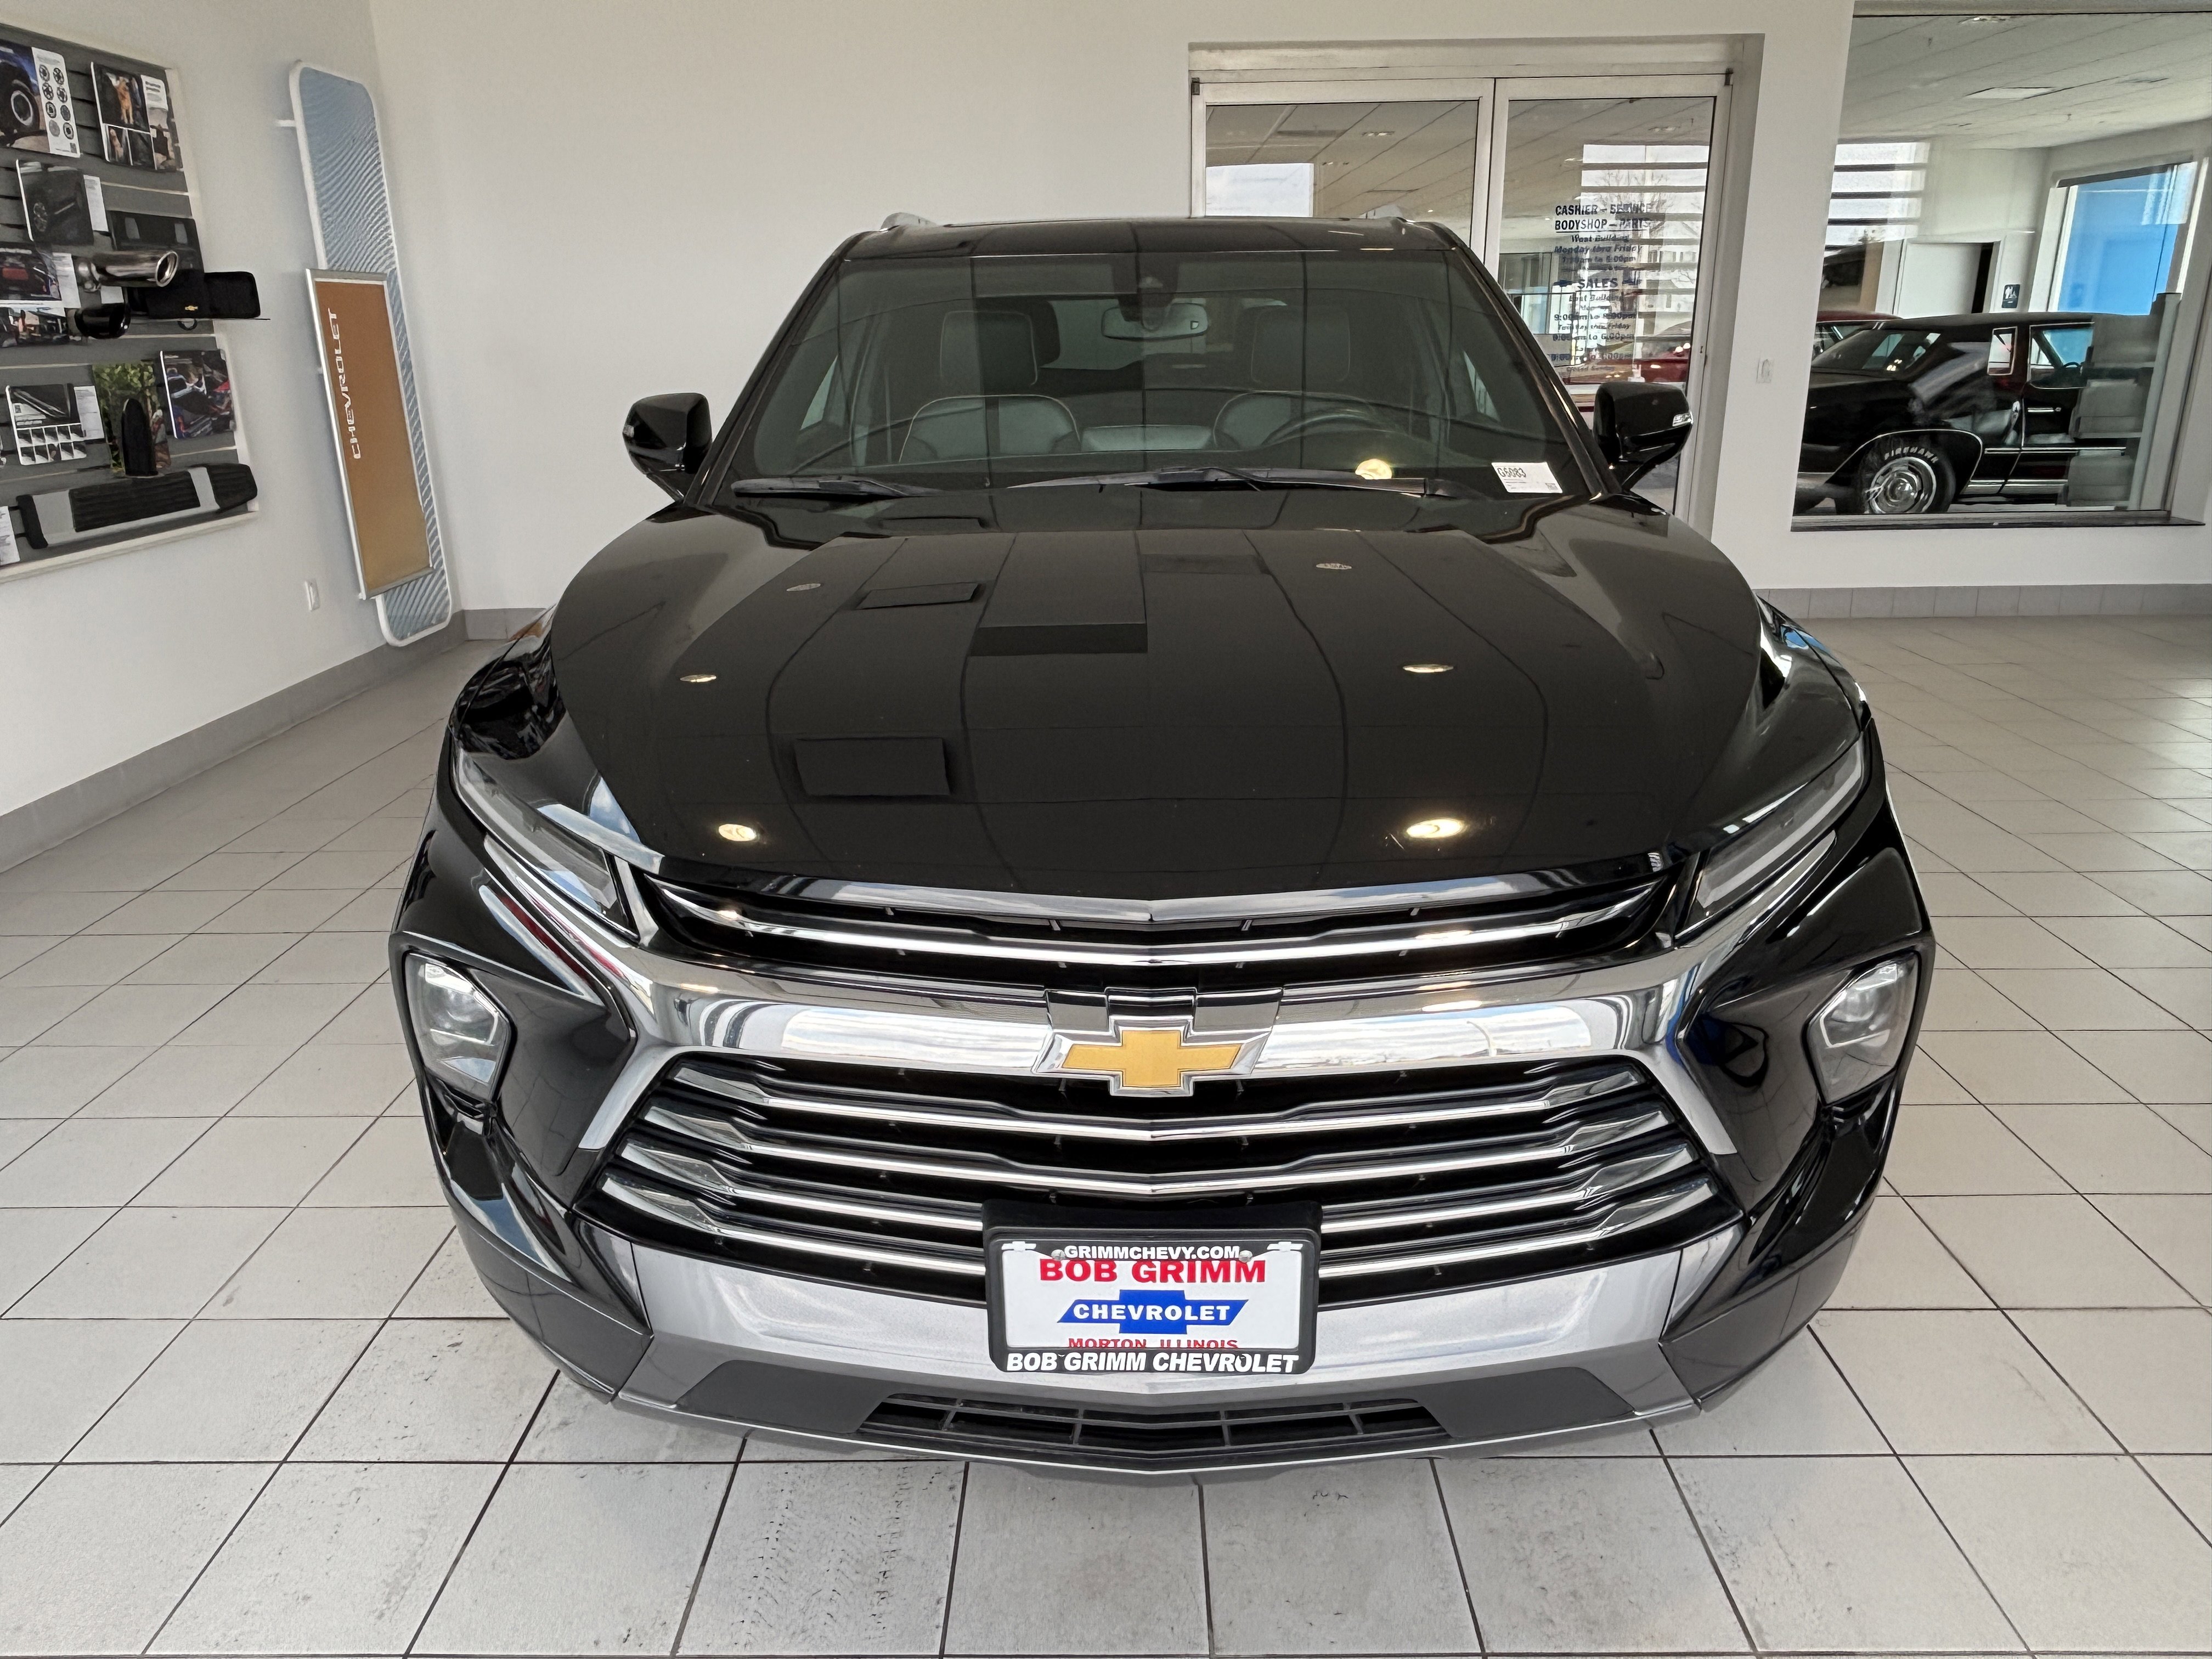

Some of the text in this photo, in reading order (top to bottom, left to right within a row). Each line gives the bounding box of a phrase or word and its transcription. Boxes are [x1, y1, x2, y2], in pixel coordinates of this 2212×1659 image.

[1555, 204, 1598, 215] CASHIER
[1555, 218, 1607, 230] BODYSHOP
[1577, 278, 1618, 289] SALES
[328, 307, 361, 459] CHEVROLET
[1064, 1245, 1240, 1260] GRIMMCHEVY.COM
[1040, 1259, 1266, 1283] BOB GRIMM
[1073, 1304, 1231, 1321] CHEVROLET
[1068, 1338, 1147, 1348] MORTON
[1006, 1352, 1300, 1373] BOB GRIMM CHEVROLET
